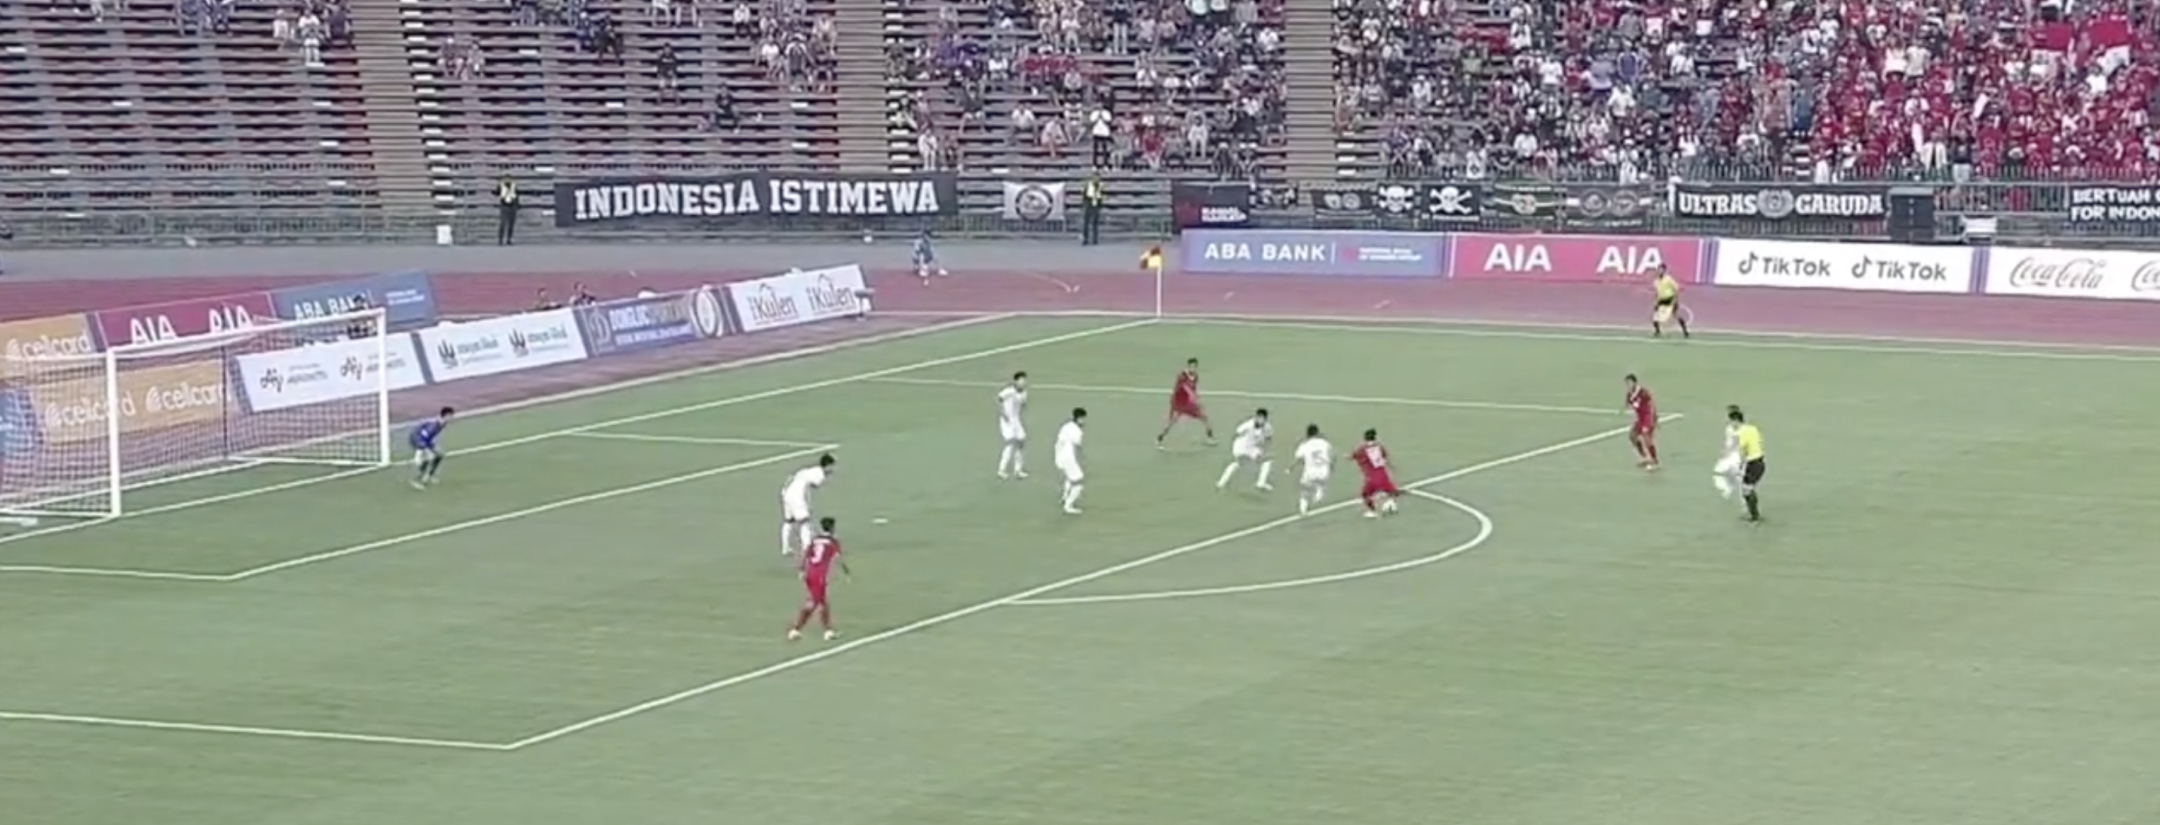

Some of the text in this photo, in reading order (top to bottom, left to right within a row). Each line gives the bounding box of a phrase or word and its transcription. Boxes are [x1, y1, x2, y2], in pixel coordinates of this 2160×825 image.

[574, 179, 940, 220] INDONESIA ISTIMEWA
[1679, 192, 1884, 215] ULTRAS GARUDA
[2073, 188, 2150, 205] BERTUAH
[2071, 205, 2106, 221] FOR
[1204, 243, 1326, 260] ABA BANK
[1484, 243, 1664, 274] AIA AIA
[1762, 257, 1948, 281] TikTok TikTok
[130, 305, 253, 344] AIA AIA
